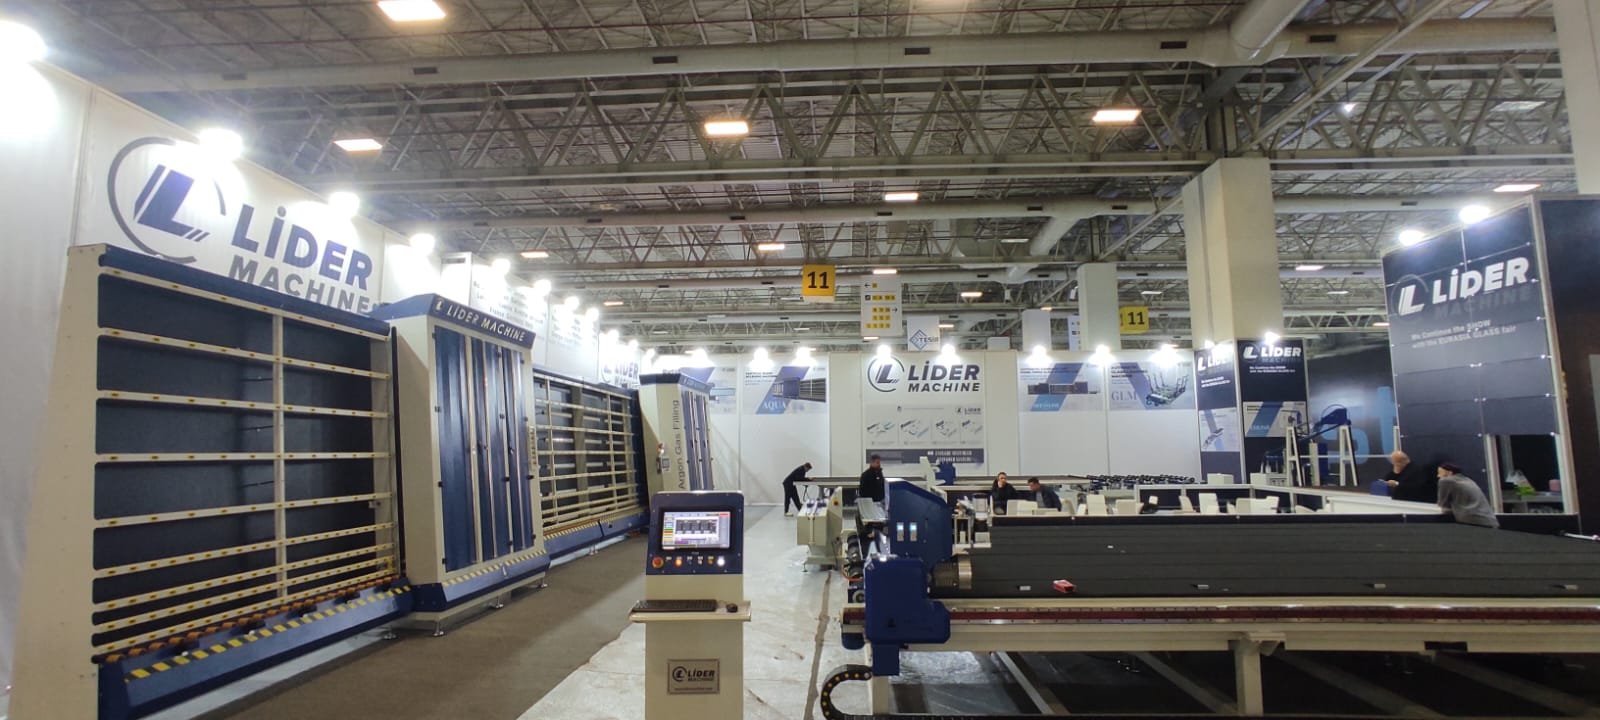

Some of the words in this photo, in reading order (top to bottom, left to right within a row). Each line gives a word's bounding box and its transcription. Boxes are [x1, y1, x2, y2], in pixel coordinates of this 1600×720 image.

[231, 203, 373, 291] LİDER
[228, 254, 372, 316] MACHINE
[807, 271, 830, 289] 11
[1431, 256, 1530, 305] LİDER
[446, 303, 479, 325] LİDER
[480, 317, 526, 342] MACHINE
[1127, 311, 1145, 325] 11
[907, 360, 980, 381] LİDER
[908, 382, 981, 393] MACHINE
[687, 667, 715, 678] LİDER
